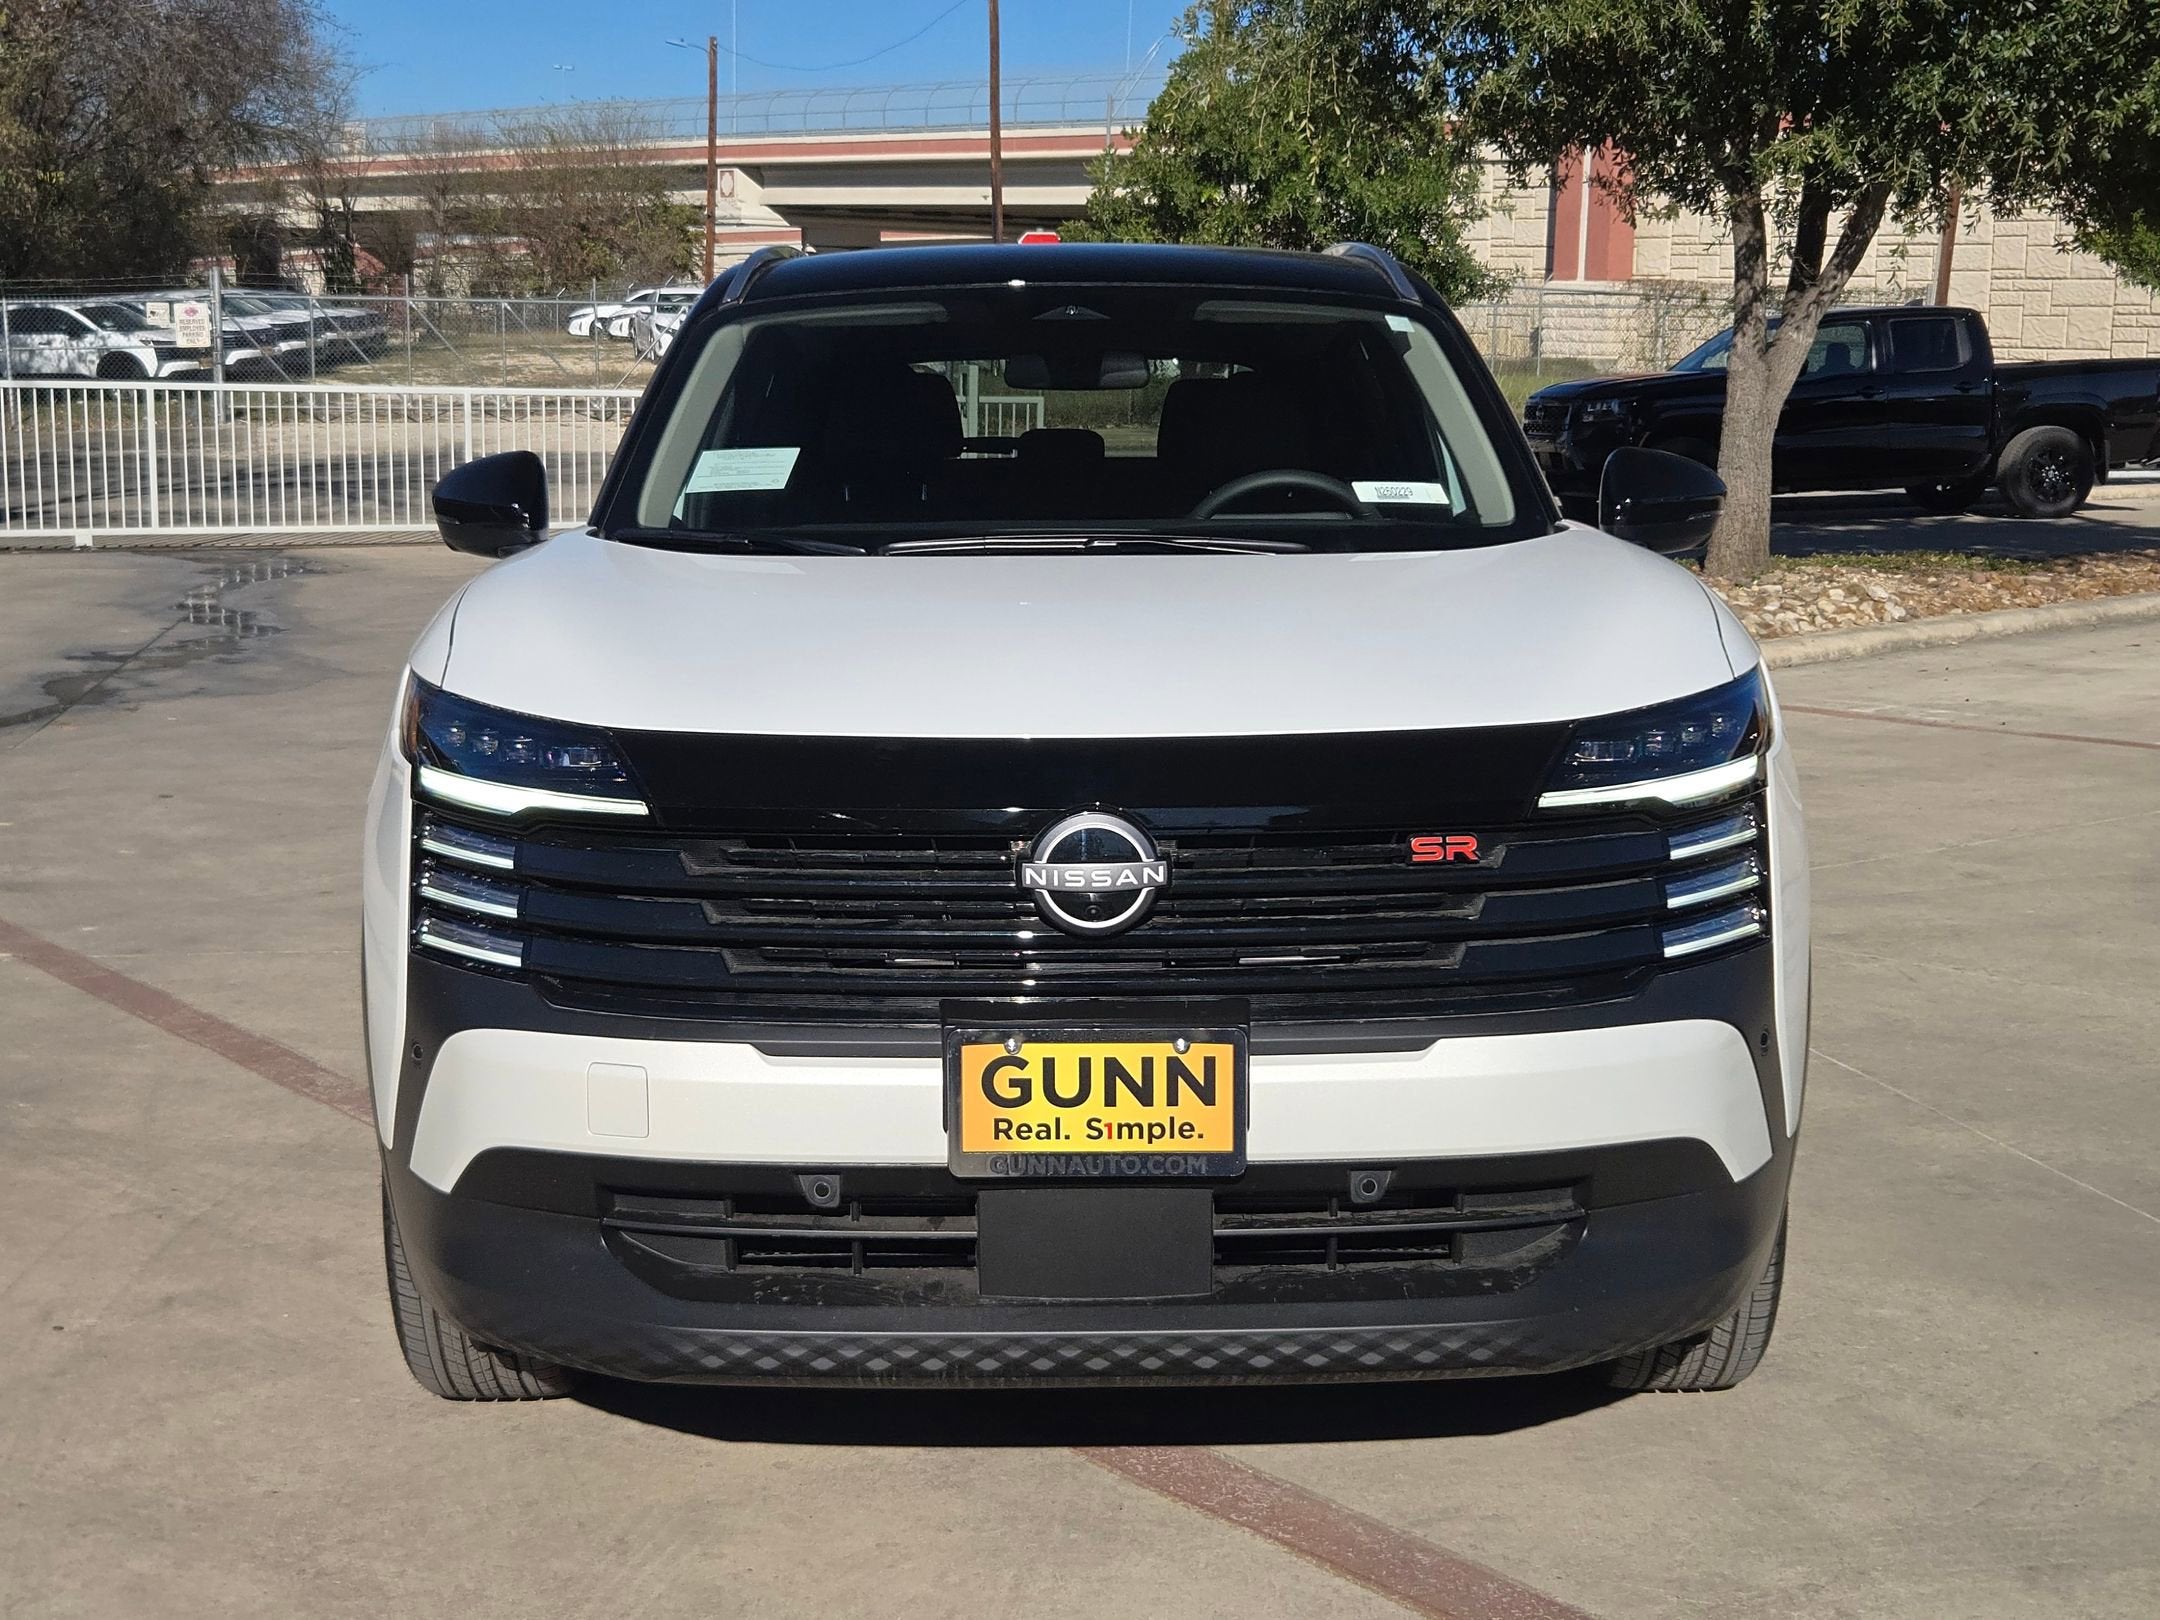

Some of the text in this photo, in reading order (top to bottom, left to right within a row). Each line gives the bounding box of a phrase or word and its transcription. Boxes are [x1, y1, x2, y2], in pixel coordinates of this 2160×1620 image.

[1411, 835, 1479, 862] SR
[1024, 865, 1165, 888] NISSAN
[981, 1055, 1217, 1108] GUNN
[993, 1117, 1070, 1141] Real.
[989, 1154, 1207, 1176] GUNNAUTO.COM
